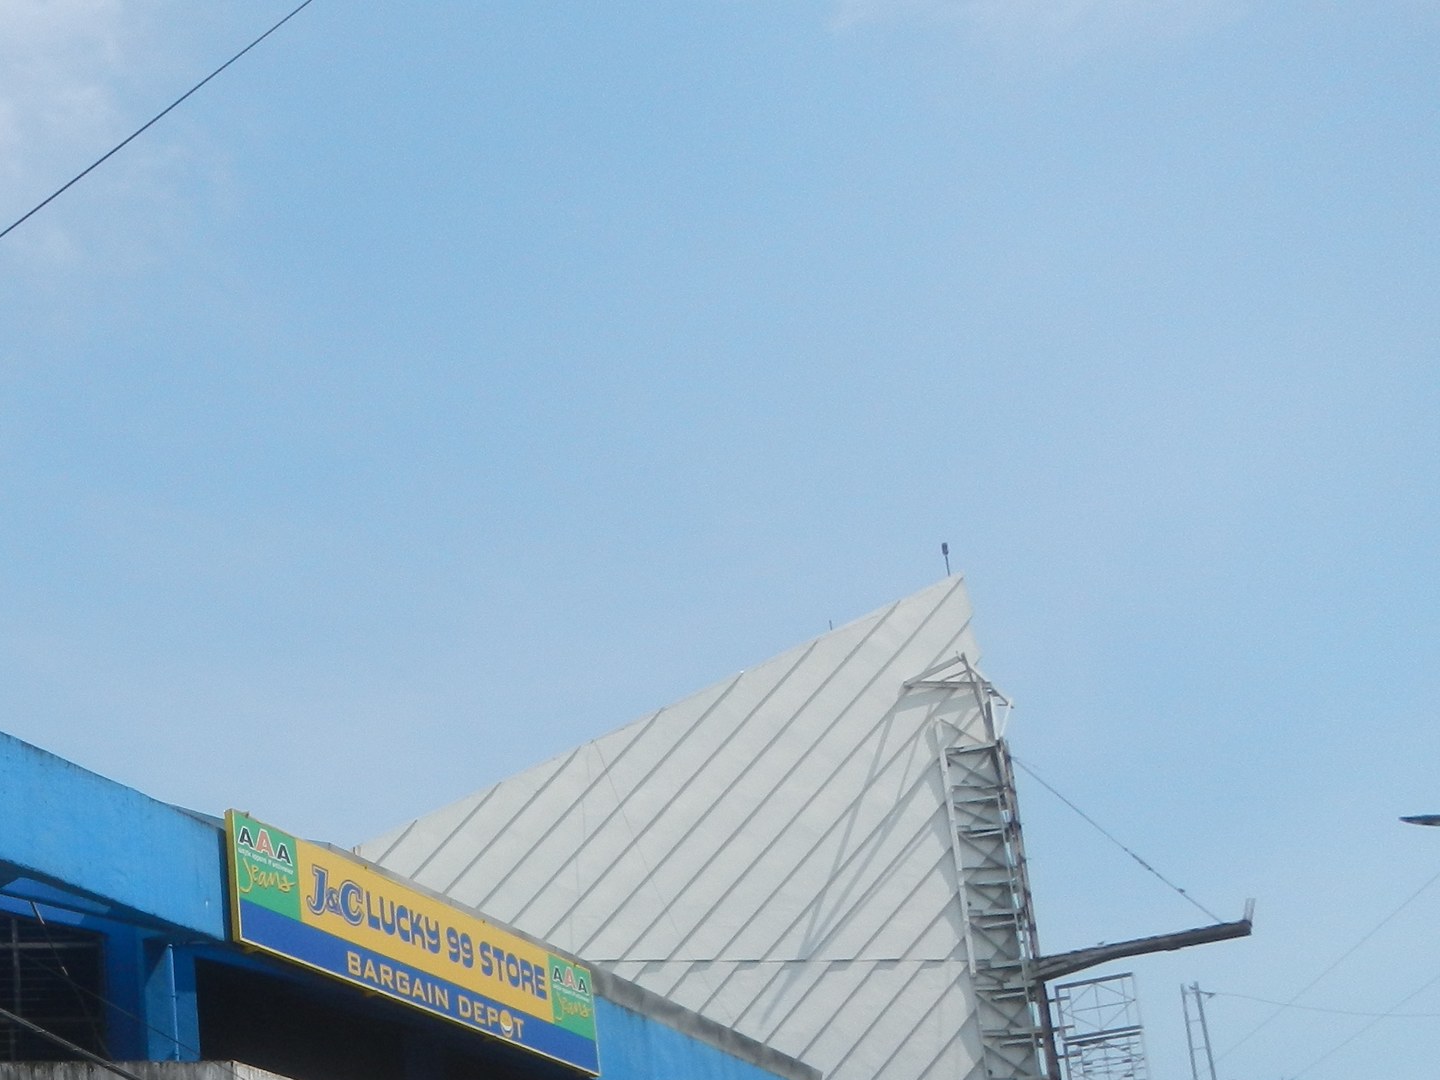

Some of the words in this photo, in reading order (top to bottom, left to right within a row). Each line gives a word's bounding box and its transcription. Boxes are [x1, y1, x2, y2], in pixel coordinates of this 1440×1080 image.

[240, 858, 296, 893] Jeans
[307, 864, 364, 926] J&C
[366, 890, 441, 953] LUCKY
[446, 927, 473, 968] 99
[479, 941, 547, 1000] STORE
[347, 950, 450, 1009] BARGAIN
[458, 996, 525, 1038] DEPOT
